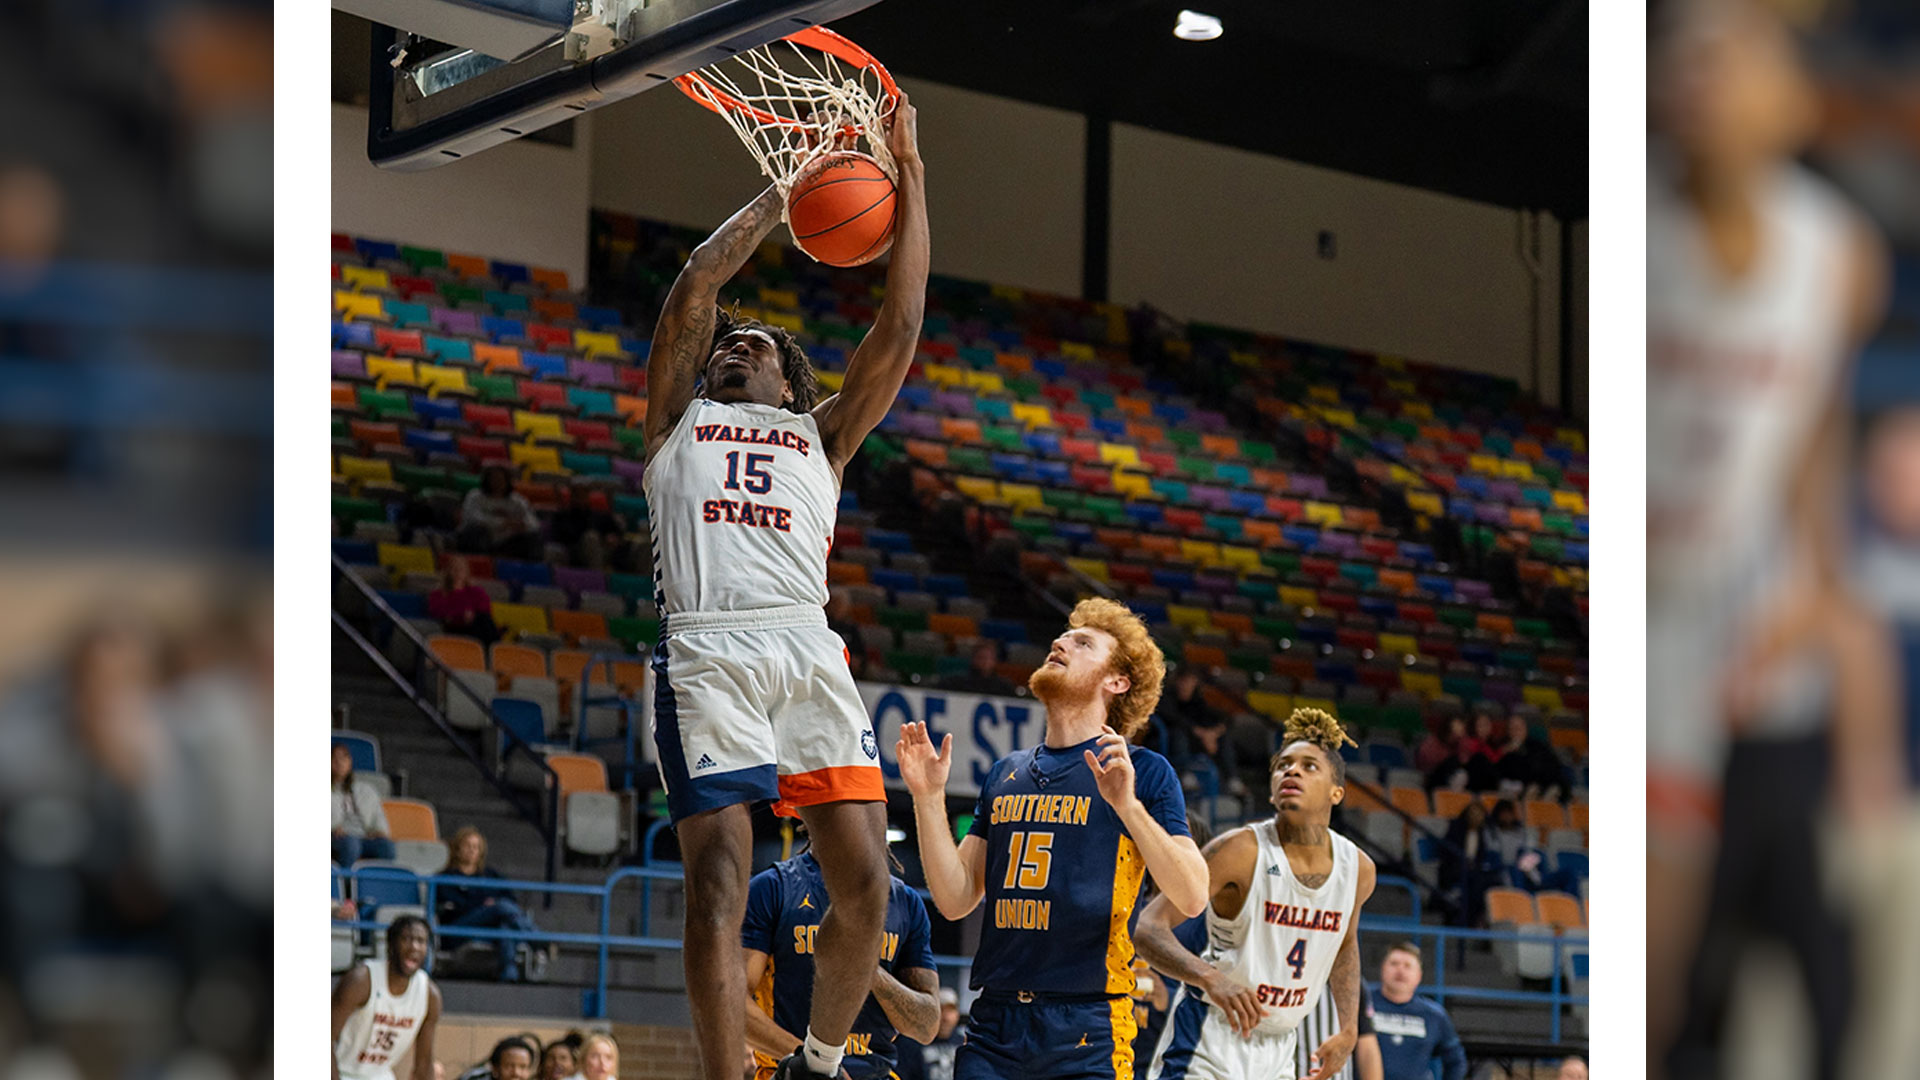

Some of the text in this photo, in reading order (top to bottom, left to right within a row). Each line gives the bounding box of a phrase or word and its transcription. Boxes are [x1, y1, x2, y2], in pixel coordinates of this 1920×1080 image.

[695, 424, 809, 457] WALLACE
[724, 451, 774, 495] 15
[703, 499, 791, 533] STATE
[973, 702, 1048, 787] ST
[990, 794, 1091, 826] SOUTHERN
[1003, 831, 1055, 890] 15
[995, 898, 1050, 931] UNION
[1264, 901, 1342, 932] WALLACE
[1286, 938, 1308, 980] 4
[1256, 983, 1308, 1008] STATE
